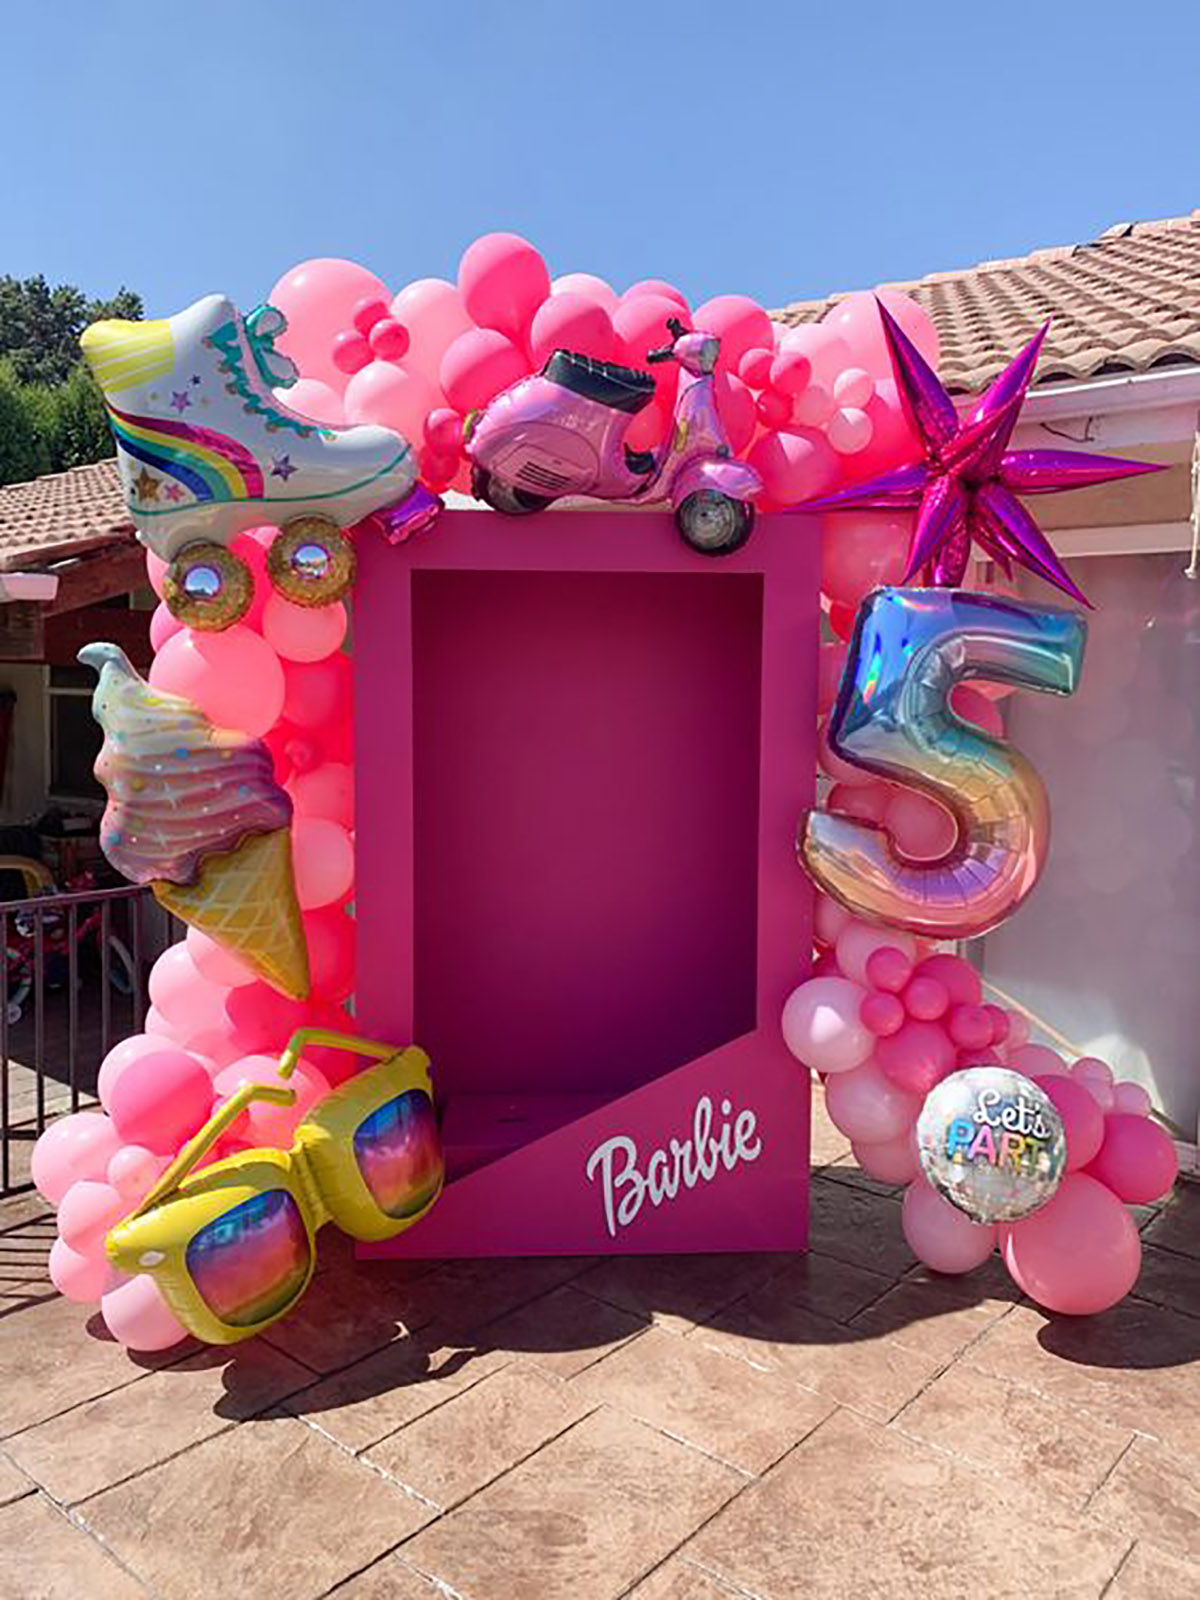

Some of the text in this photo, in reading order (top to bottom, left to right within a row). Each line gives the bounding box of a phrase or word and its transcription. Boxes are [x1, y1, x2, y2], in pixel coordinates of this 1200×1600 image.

[796, 586, 1088, 940] 5
[586, 1096, 761, 1237] Barbie
[973, 1088, 1051, 1139] Let's
